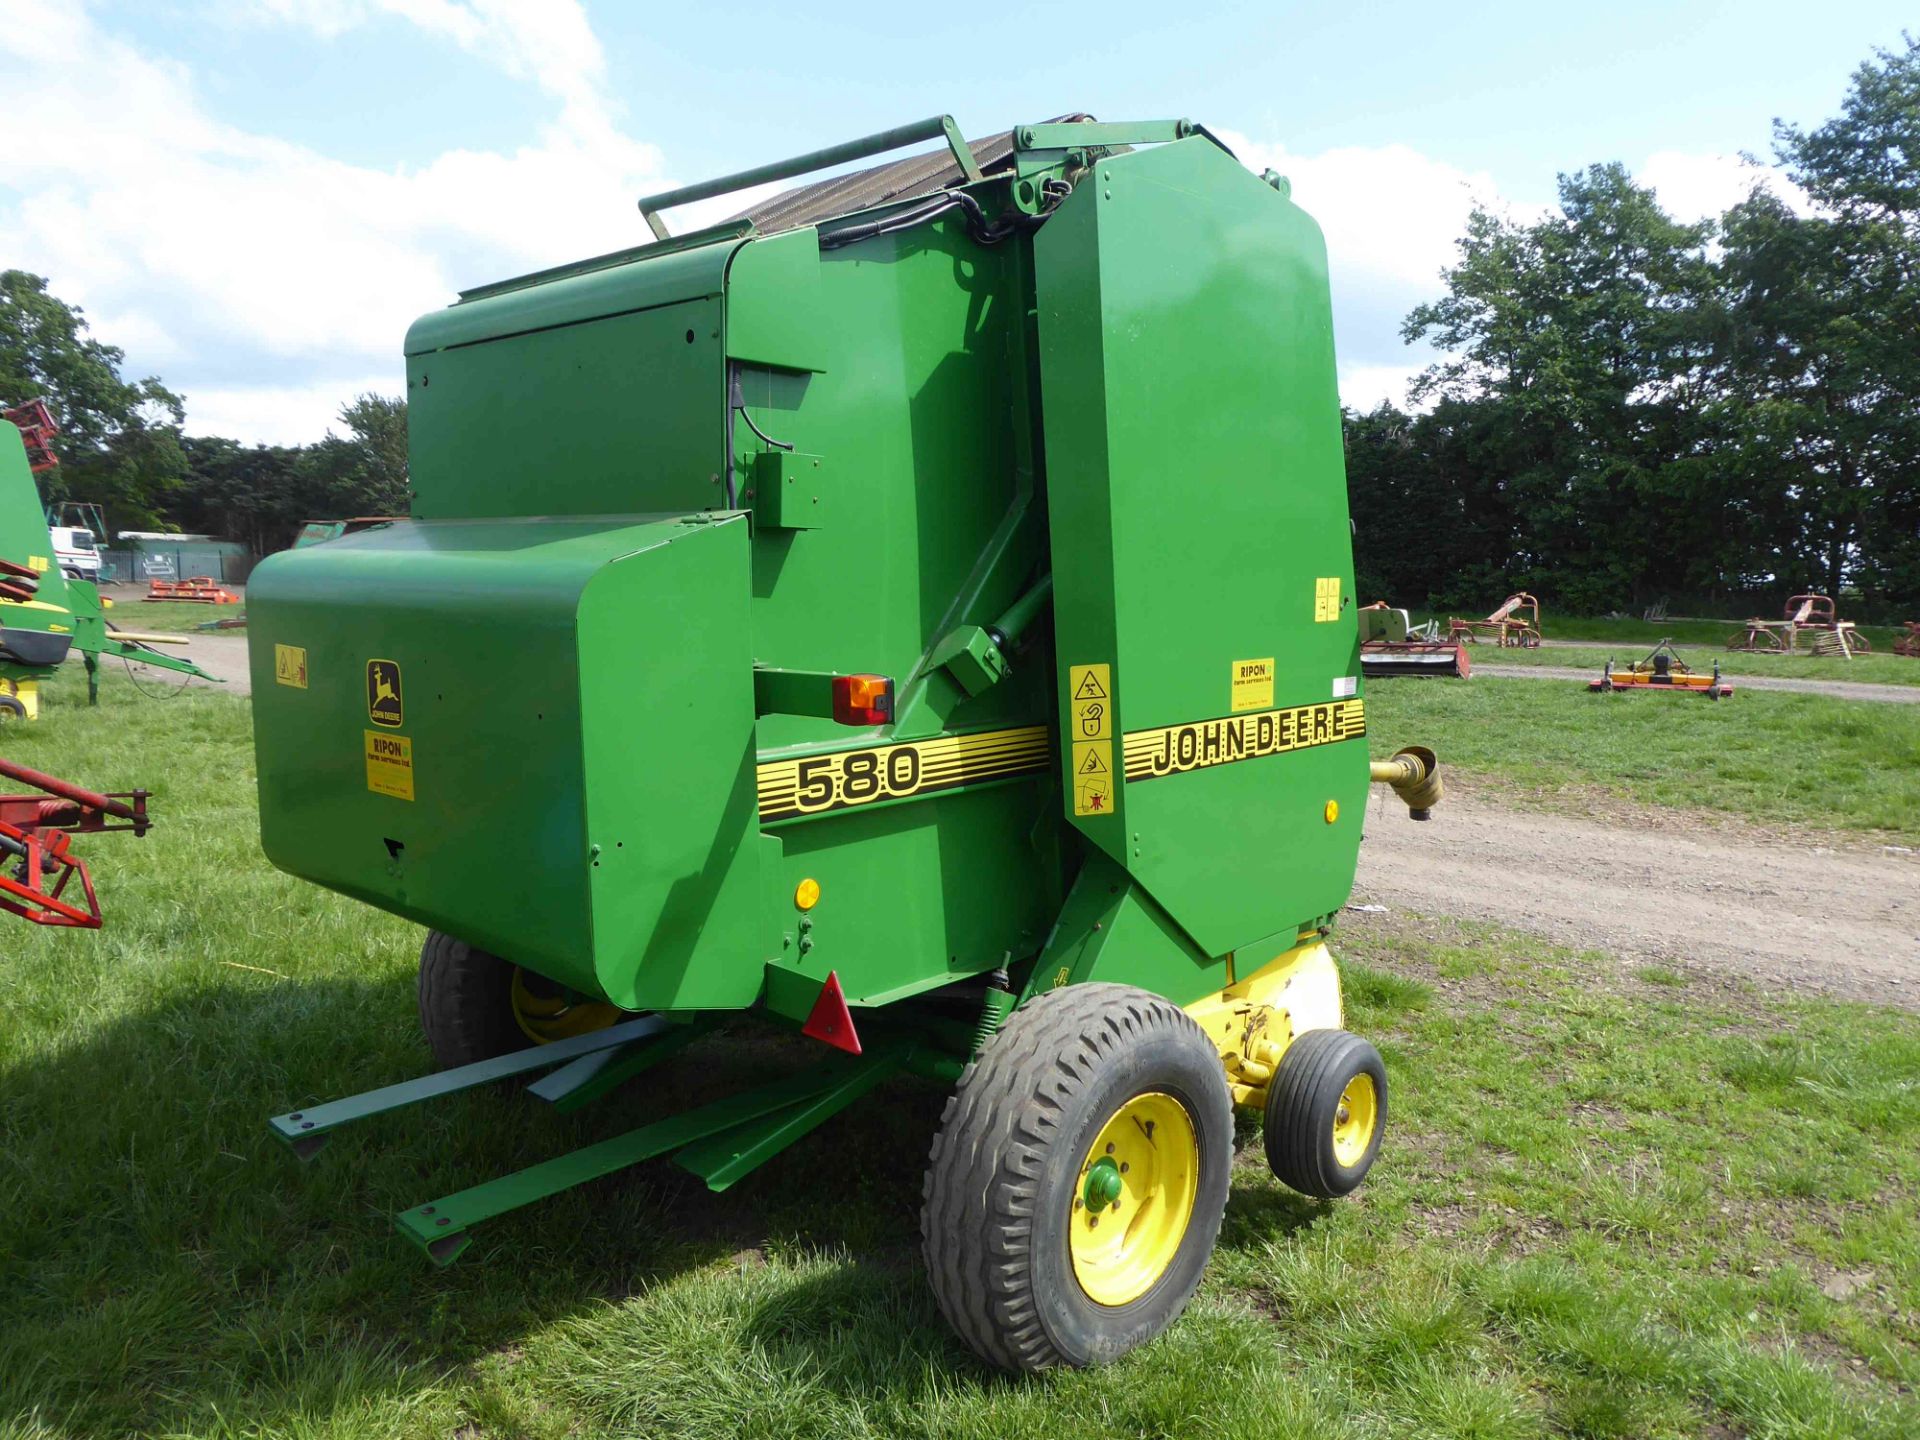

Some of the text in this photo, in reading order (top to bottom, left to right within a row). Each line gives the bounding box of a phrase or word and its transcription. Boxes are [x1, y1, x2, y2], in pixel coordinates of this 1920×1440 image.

[1240, 664, 1265, 678] RIPON
[372, 710, 384, 719] JOHN
[373, 737, 402, 757] RIPON
[1154, 704, 1344, 773] JOHN DEERE
[797, 746, 920, 807] 580
